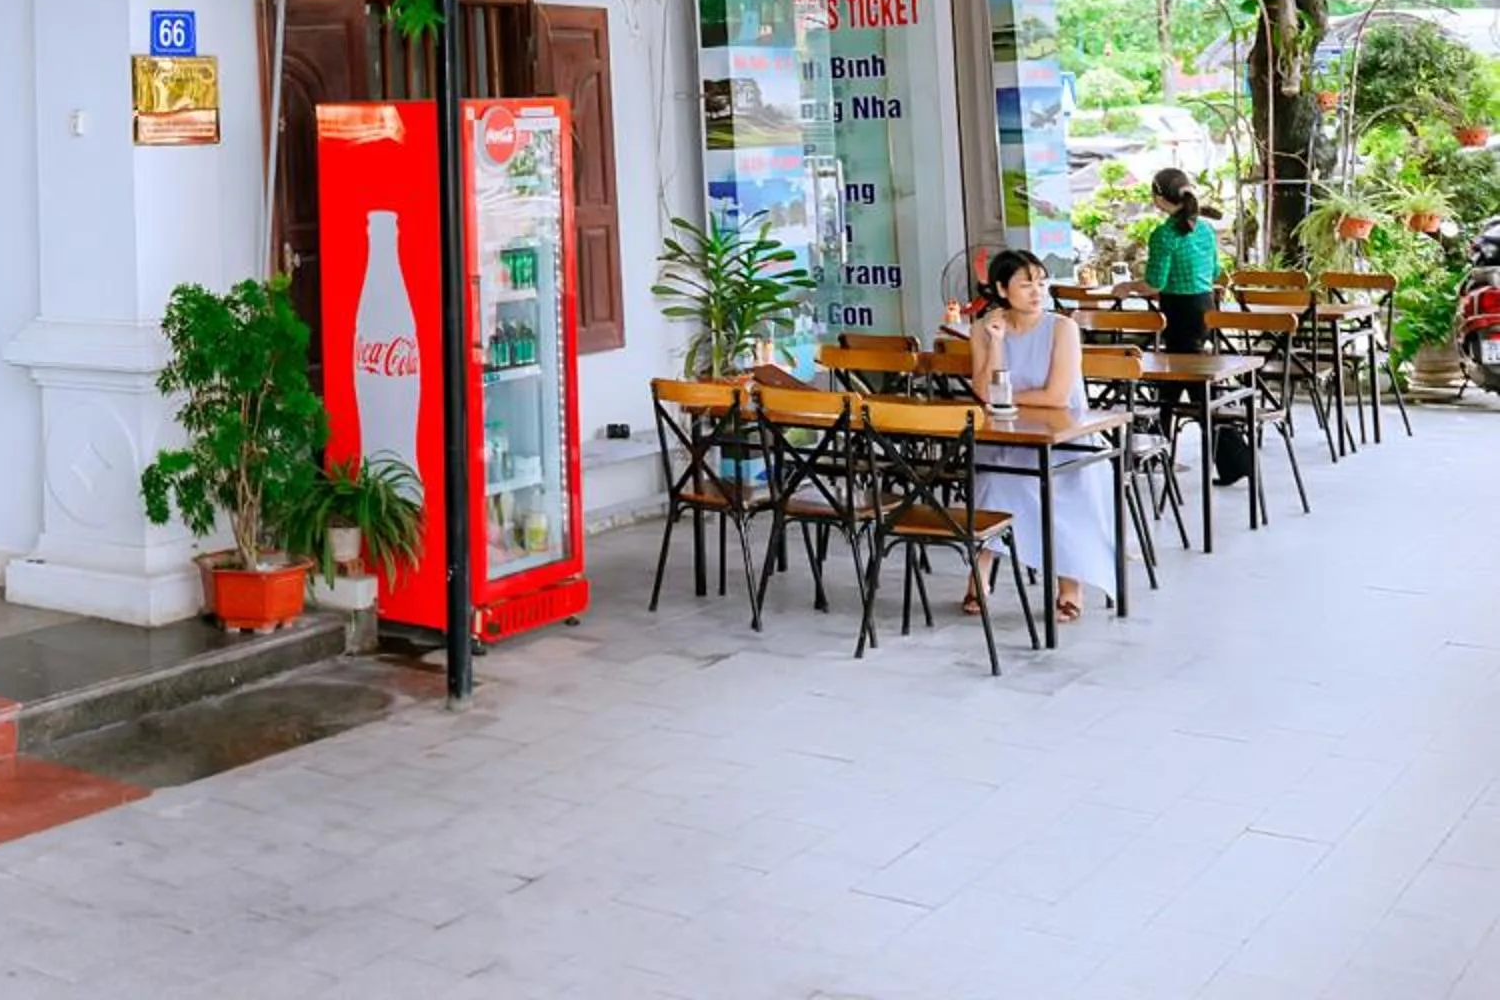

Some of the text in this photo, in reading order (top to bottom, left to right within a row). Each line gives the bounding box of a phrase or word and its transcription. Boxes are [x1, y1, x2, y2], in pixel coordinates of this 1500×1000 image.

[159, 19, 185, 47] 66
[851, 96, 902, 119] Nha
[837, 264, 903, 288] rang
